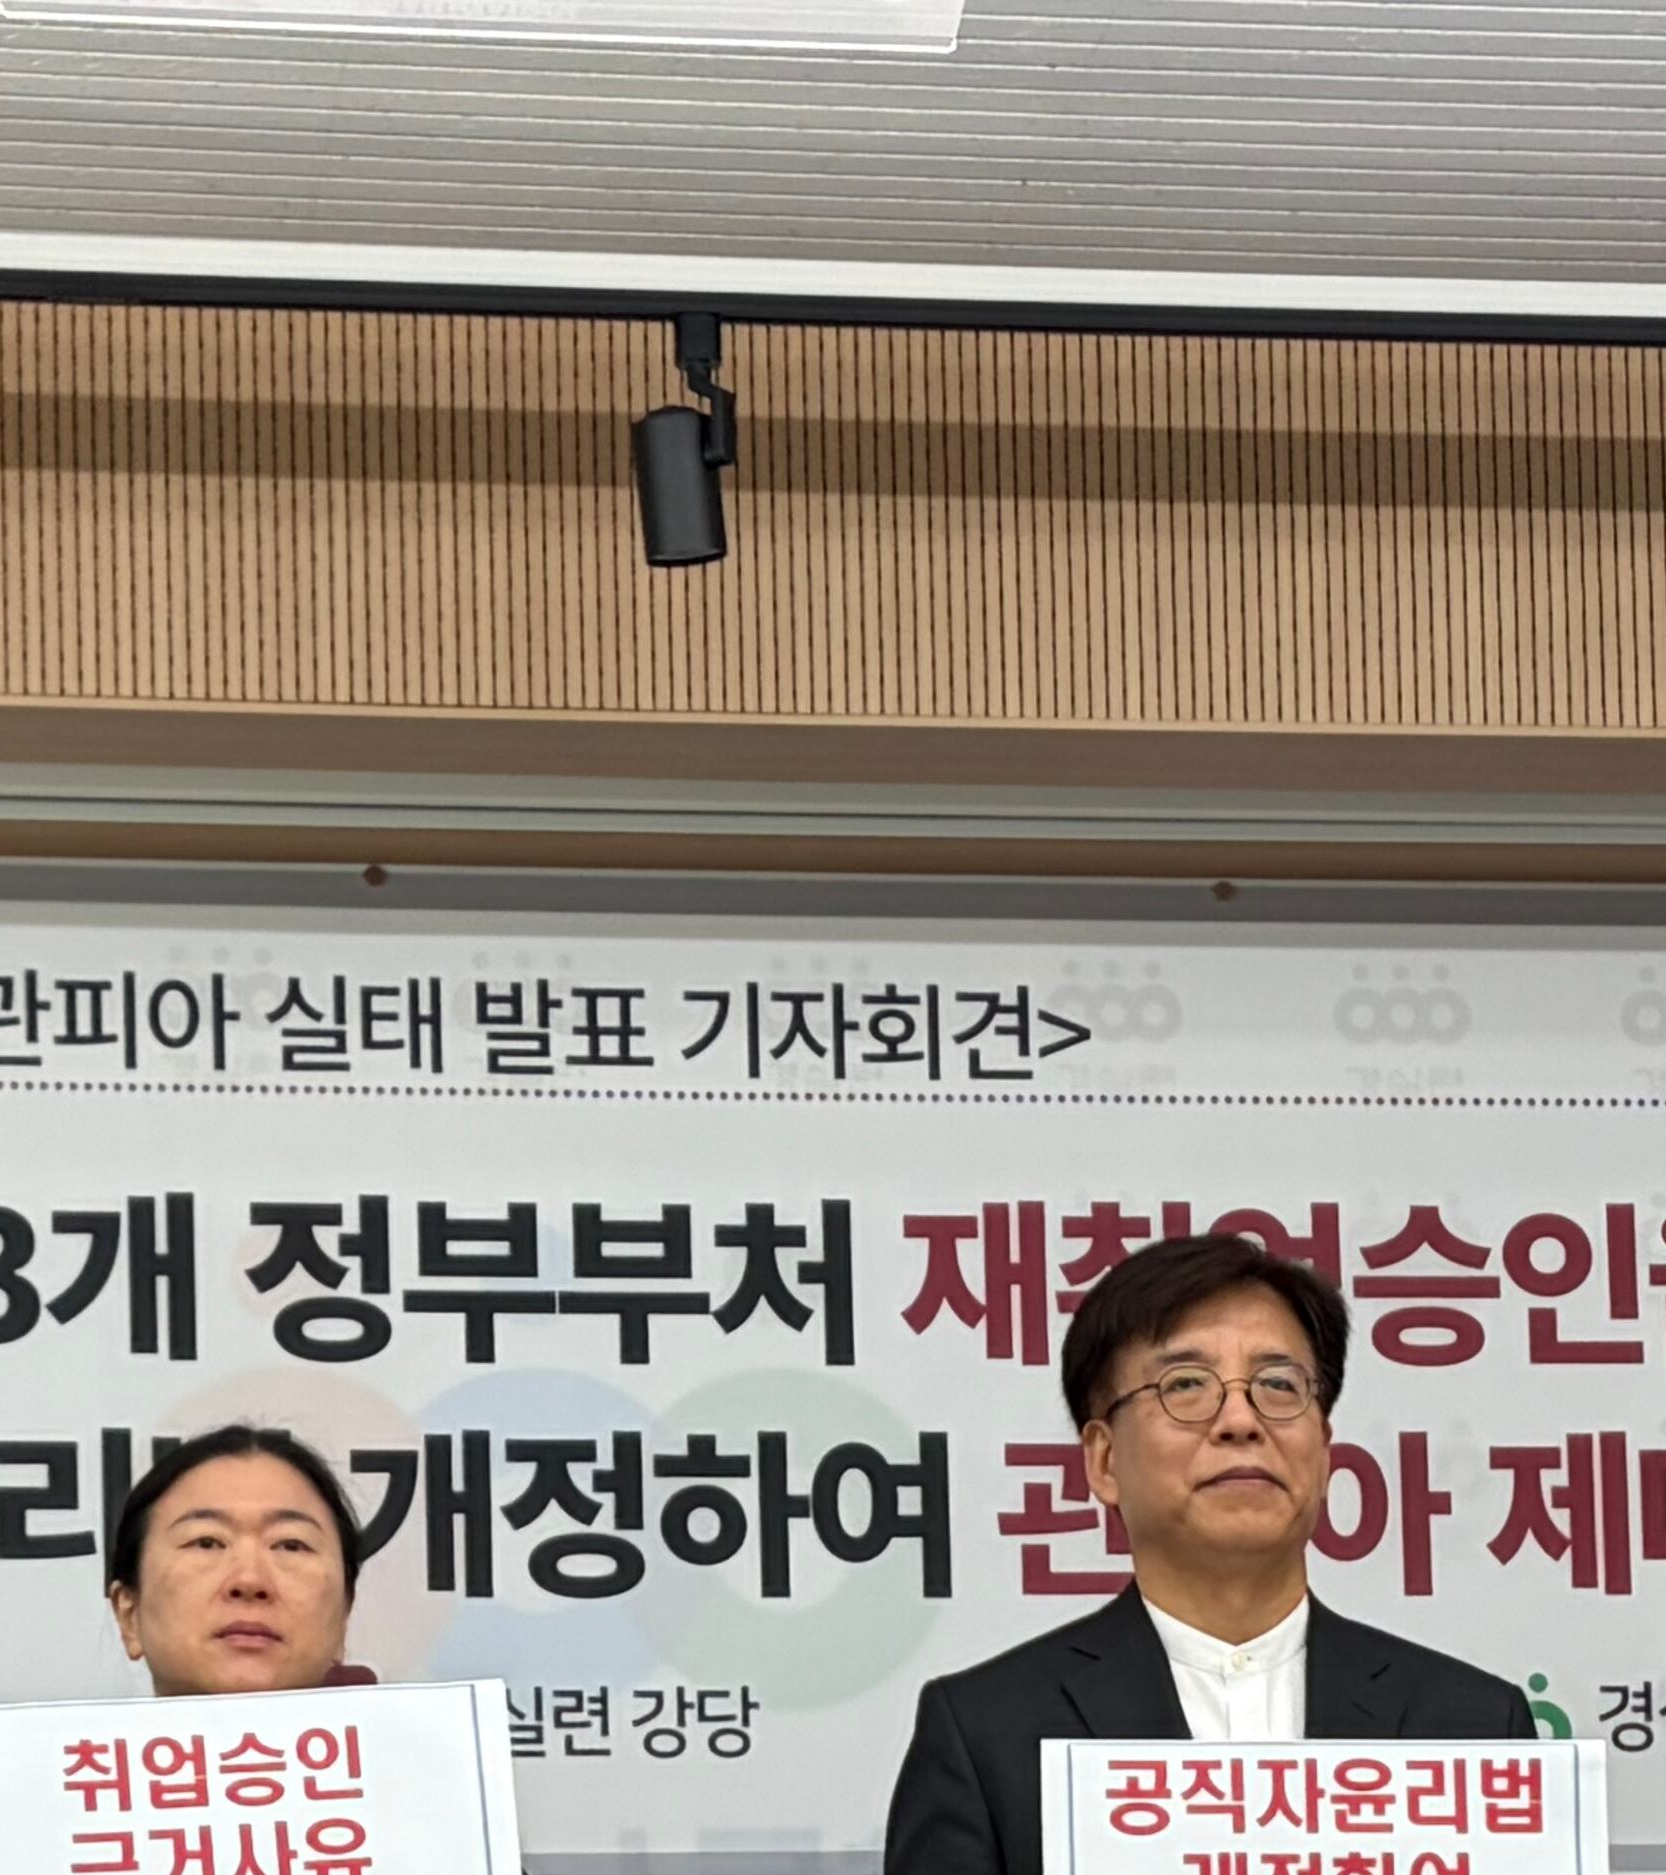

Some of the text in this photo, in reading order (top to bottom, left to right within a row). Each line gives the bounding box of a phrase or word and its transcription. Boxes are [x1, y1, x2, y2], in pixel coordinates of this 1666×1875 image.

[266, 974, 443, 1074] 실태
[475, 977, 654, 1075] 발표
[680, 980, 1093, 1081] 기자회견>
[244, 1194, 856, 1366] 정부부처
[349, 1428, 950, 1601] 개정하여
[997, 1431, 1452, 1596] 관아
[62, 1725, 365, 1813] 취업승인
[505, 1684, 760, 1760] 실련 강당
[1103, 1757, 1545, 1837] 공직자윤리법
